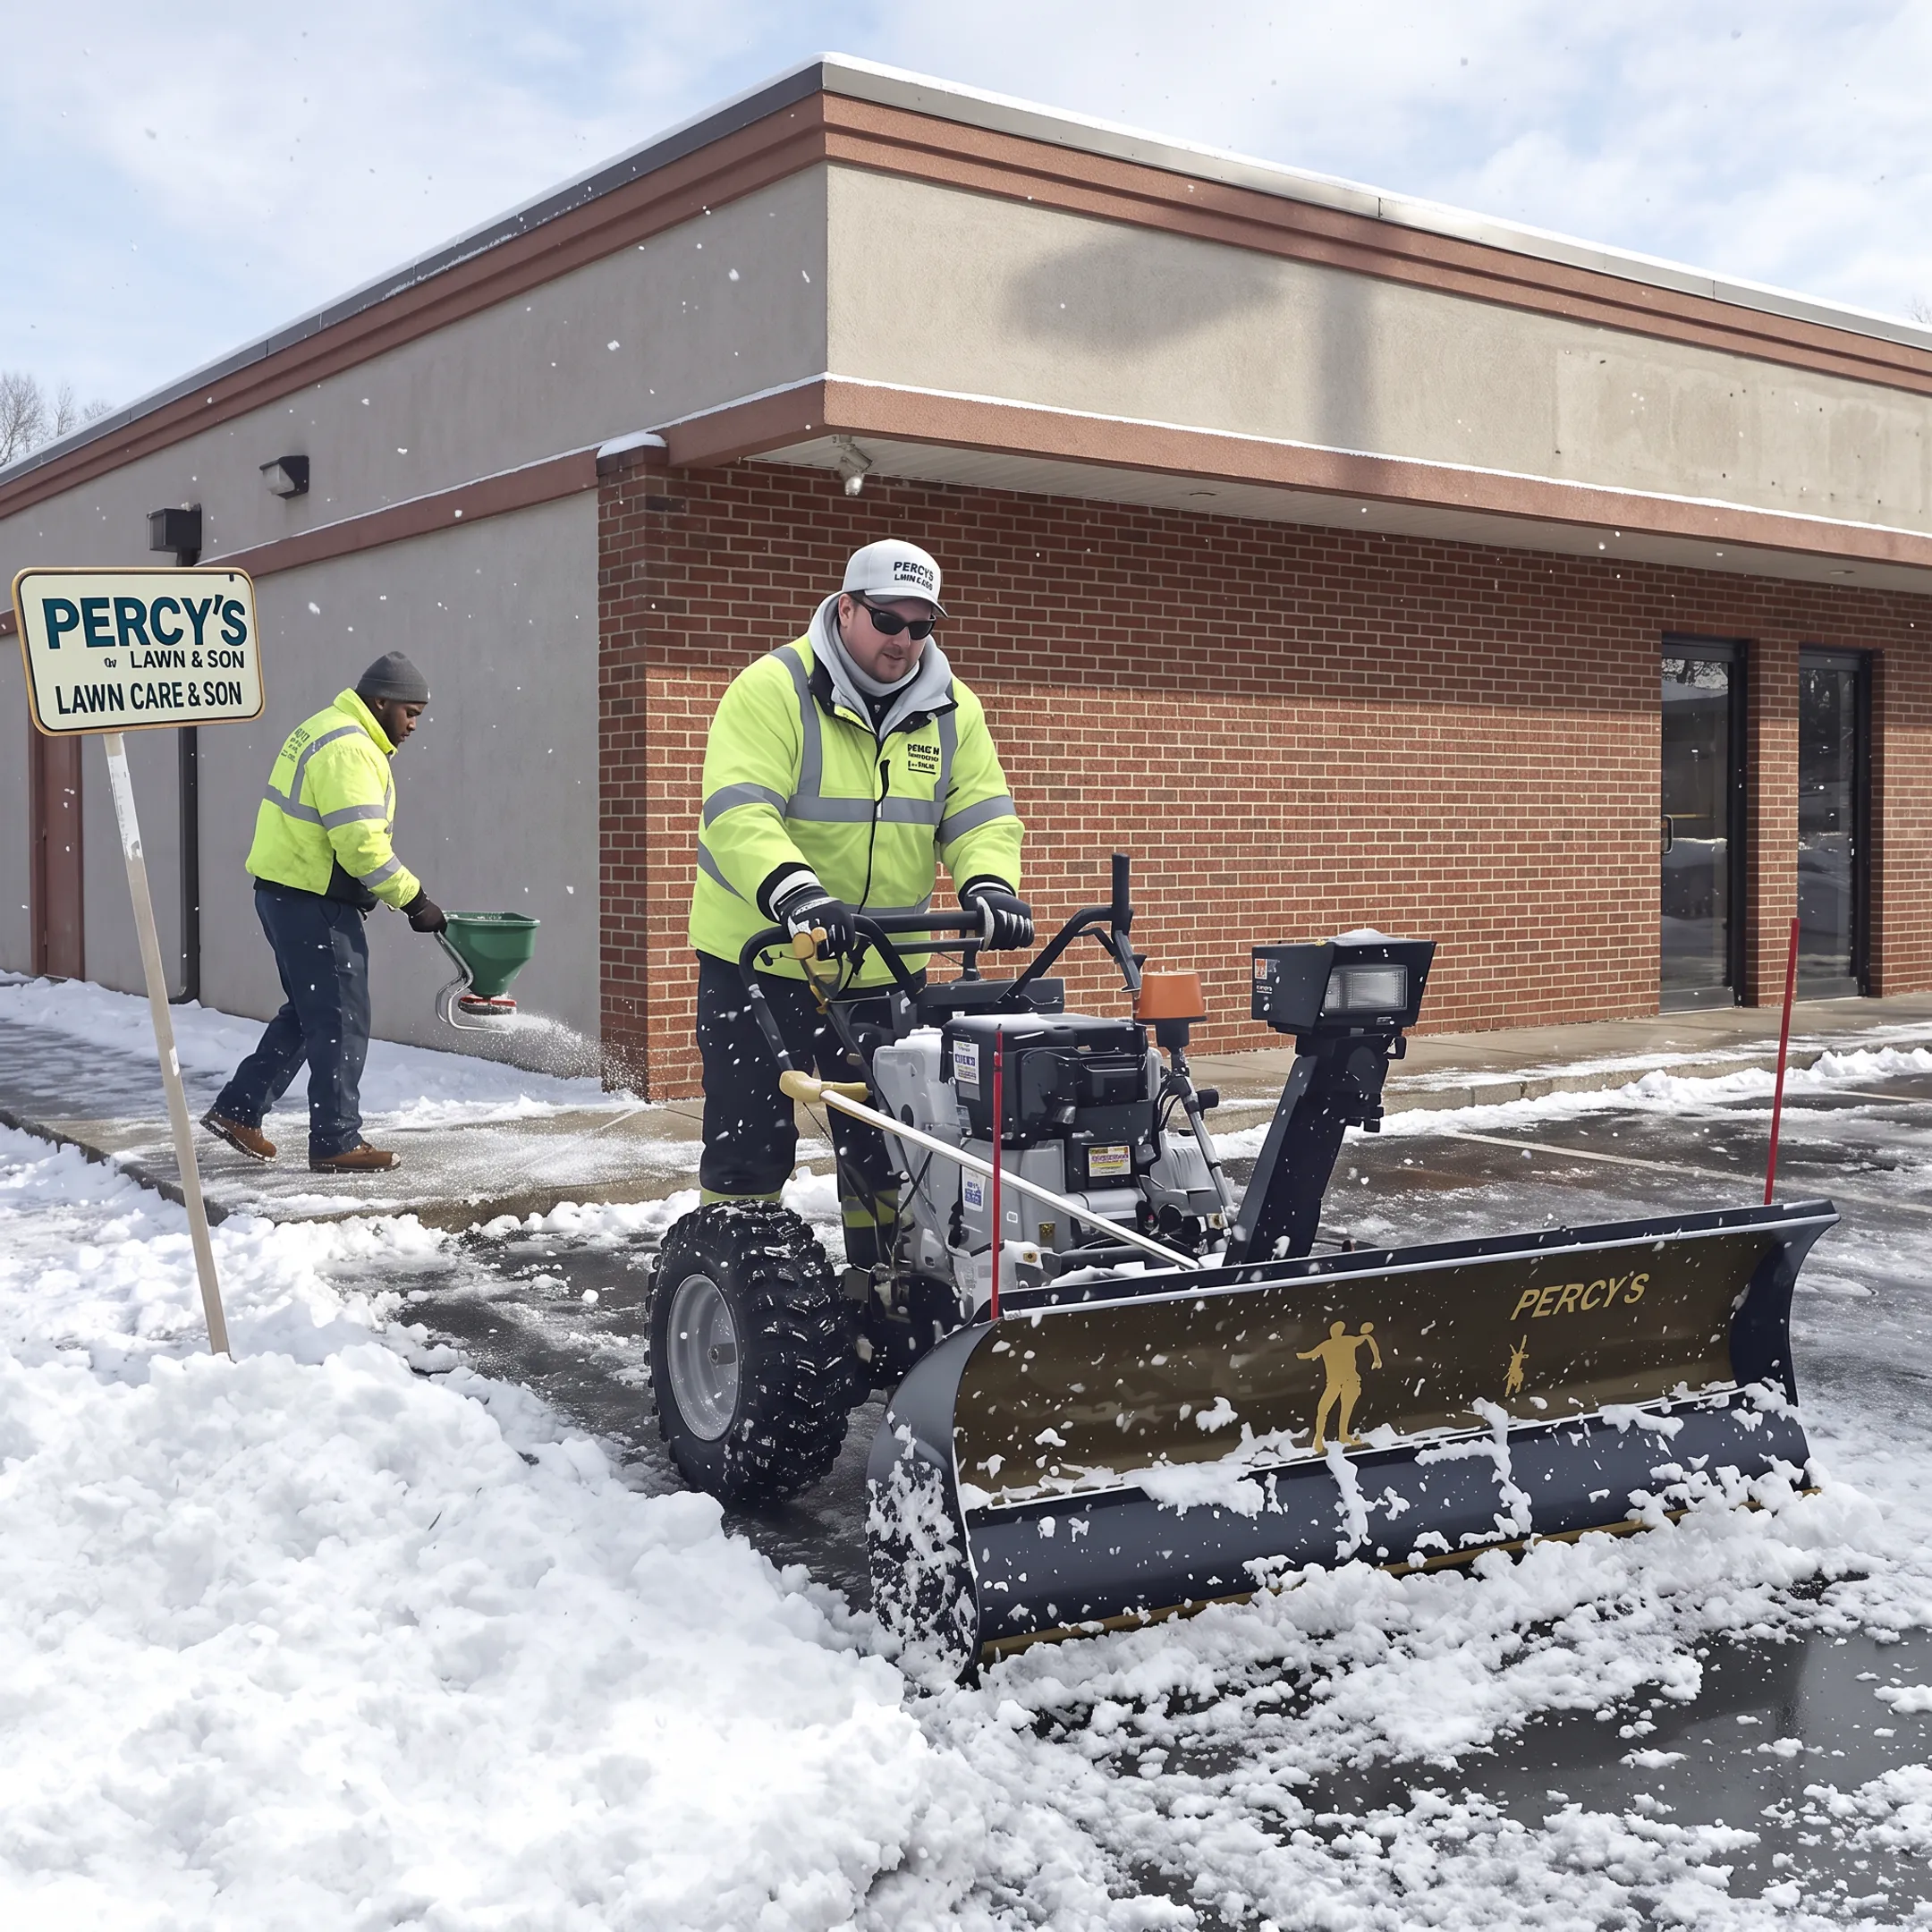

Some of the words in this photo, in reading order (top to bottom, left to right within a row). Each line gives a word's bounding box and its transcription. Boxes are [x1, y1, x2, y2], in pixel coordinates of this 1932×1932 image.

[42, 594, 248, 649] PERCY'S
[130, 650, 186, 668] LAWN
[191, 650, 203, 668] &
[208, 650, 245, 668] SON
[55, 682, 125, 715] LAWN
[130, 682, 184, 710] CARE
[187, 682, 201, 707] &
[204, 681, 242, 706] SON
